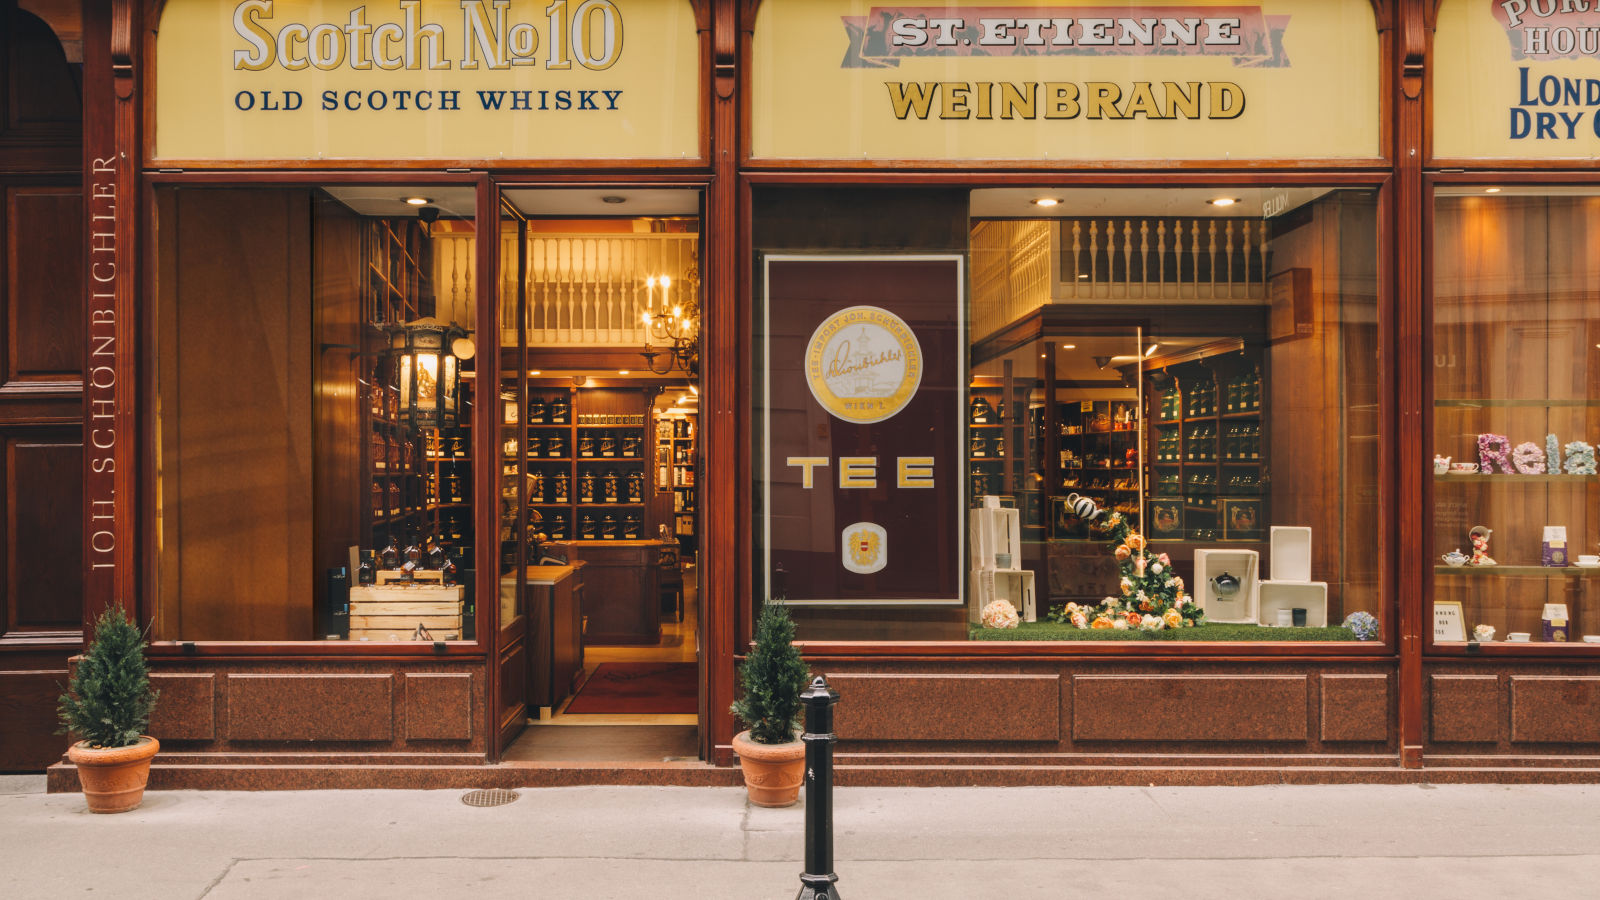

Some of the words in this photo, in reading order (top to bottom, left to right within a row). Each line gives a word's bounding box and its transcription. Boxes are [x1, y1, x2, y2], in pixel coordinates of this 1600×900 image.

[233, 0, 451, 71] Scotch
[234, 90, 303, 111] OLD
[321, 90, 461, 111] SCOTCH
[477, 90, 624, 111] WHISKY
[884, 81, 1246, 120] WEINBRAND
[1509, 108, 1584, 139] DRY
[89, 154, 117, 474] SCHÖNBICHLER
[786, 456, 935, 489] TEE
